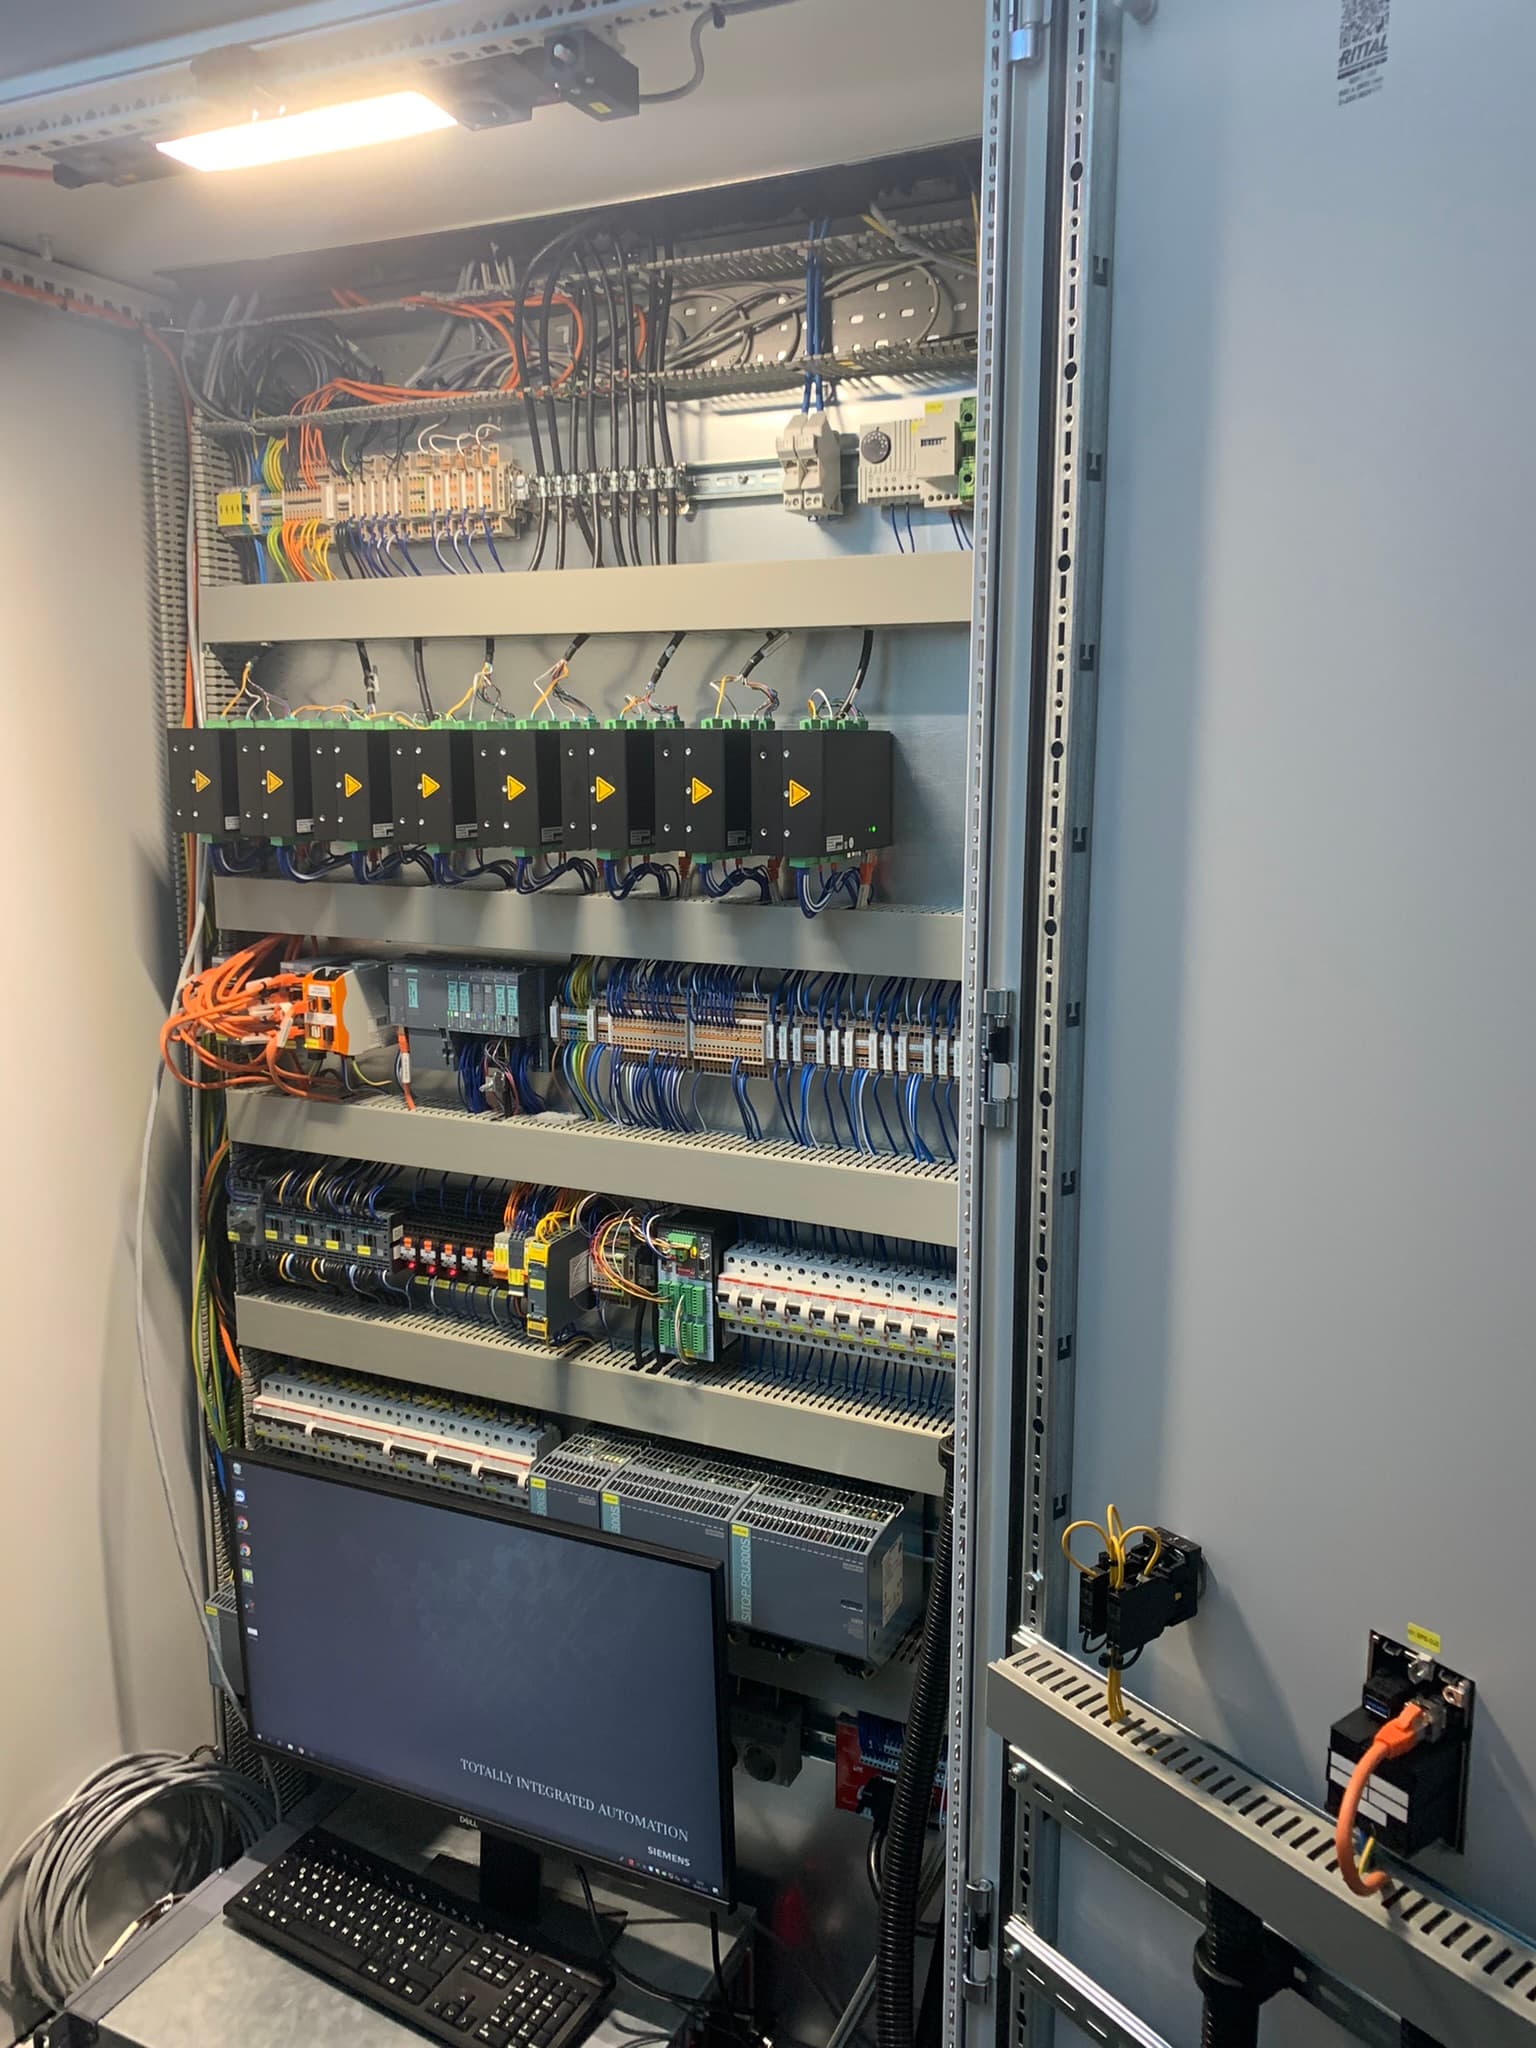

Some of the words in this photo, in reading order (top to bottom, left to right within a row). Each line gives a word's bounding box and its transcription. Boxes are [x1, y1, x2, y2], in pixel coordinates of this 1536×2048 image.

[1338, 33, 1388, 67] RITTAL
[740, 1538, 751, 1588] PSU300S
[740, 1589, 752, 1622] SITOP
[460, 1758, 513, 1785] TOTALLY
[516, 1776, 595, 1811] INTEGRATED
[598, 1803, 689, 1842] AUTOMATION
[460, 1815, 479, 1828] DELL
[647, 1846, 691, 1867] SIEMENS
